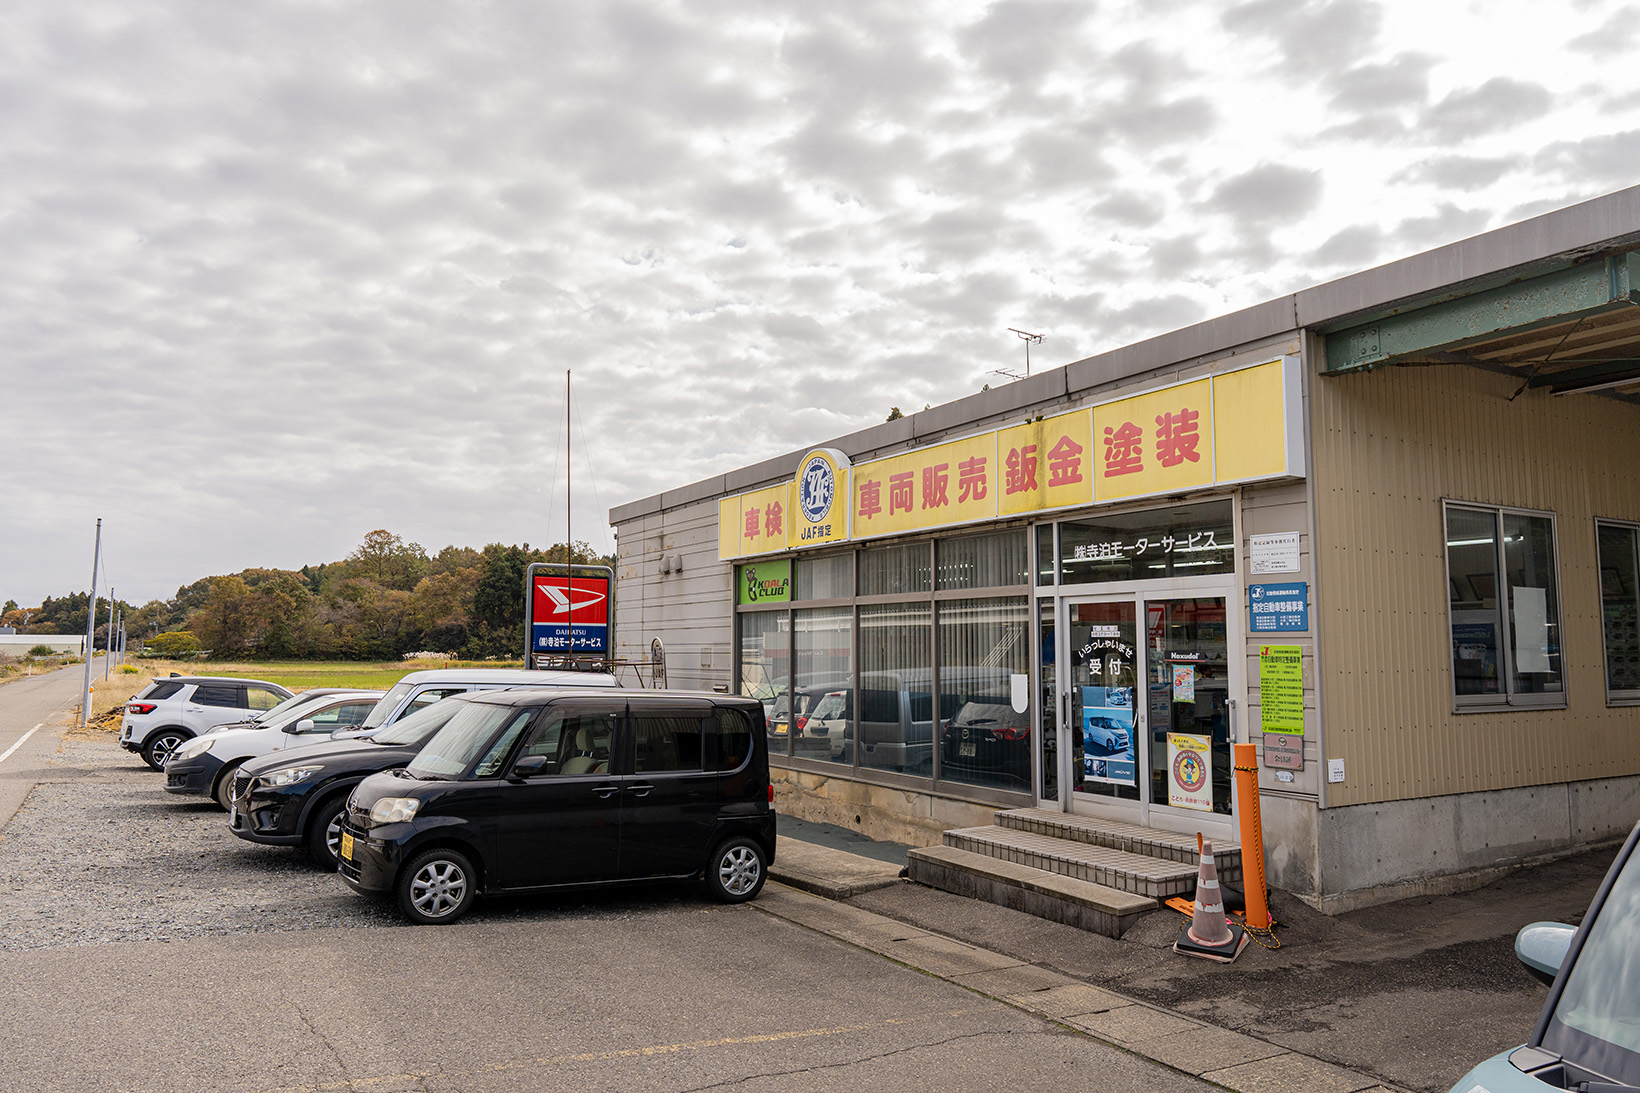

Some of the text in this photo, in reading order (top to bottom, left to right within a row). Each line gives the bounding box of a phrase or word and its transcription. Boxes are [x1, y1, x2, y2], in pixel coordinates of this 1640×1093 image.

[744, 501, 783, 541] 車検
[858, 456, 988, 520] 車両販売
[800, 524, 832, 541] JAF指定
[757, 578, 789, 589] KOALA
[759, 587, 784, 597] CLUB
[1078, 639, 1133, 659] いらっしゃいませ
[1170, 652, 1199, 660] Noxudol
[1089, 658, 1122, 675] 受付
